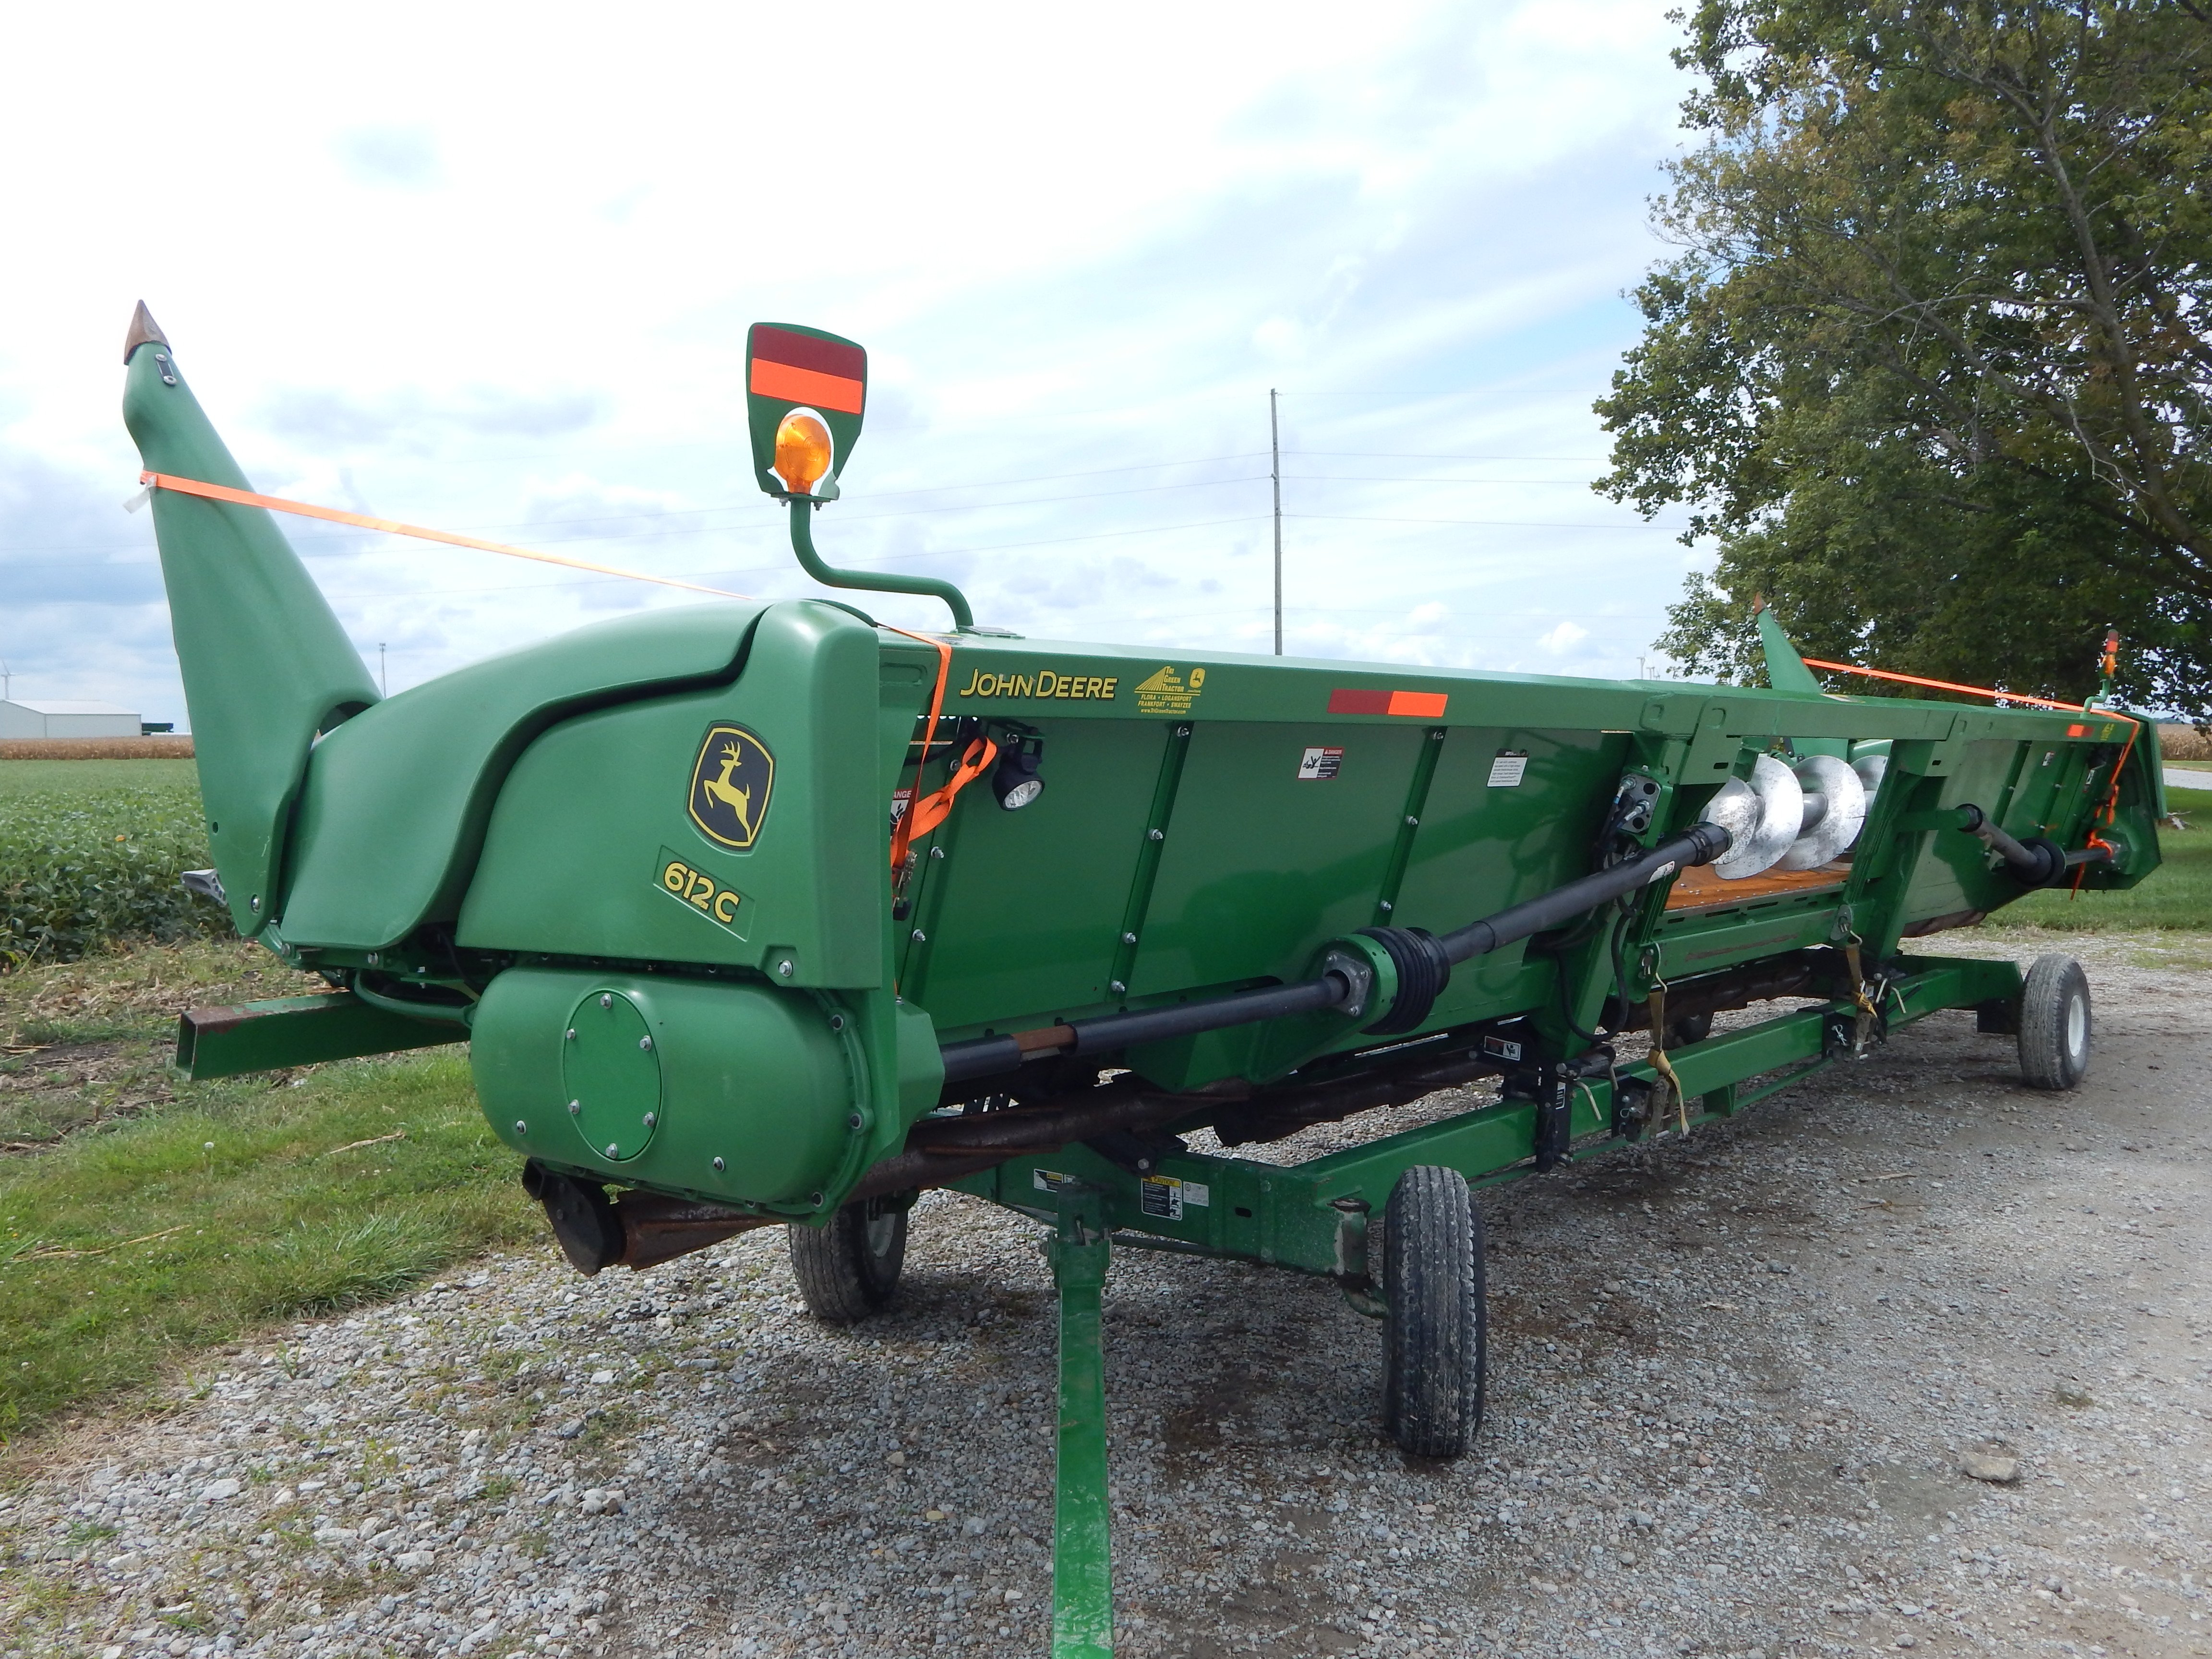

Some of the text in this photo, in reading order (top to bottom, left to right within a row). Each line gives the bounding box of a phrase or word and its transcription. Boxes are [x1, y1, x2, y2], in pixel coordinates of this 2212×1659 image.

[960, 668, 1118, 699] JOHN DEERE
[1162, 684, 1184, 692] TRACTOR
[1164, 675, 1180, 683] GREEN
[664, 861, 740, 924] 612C
